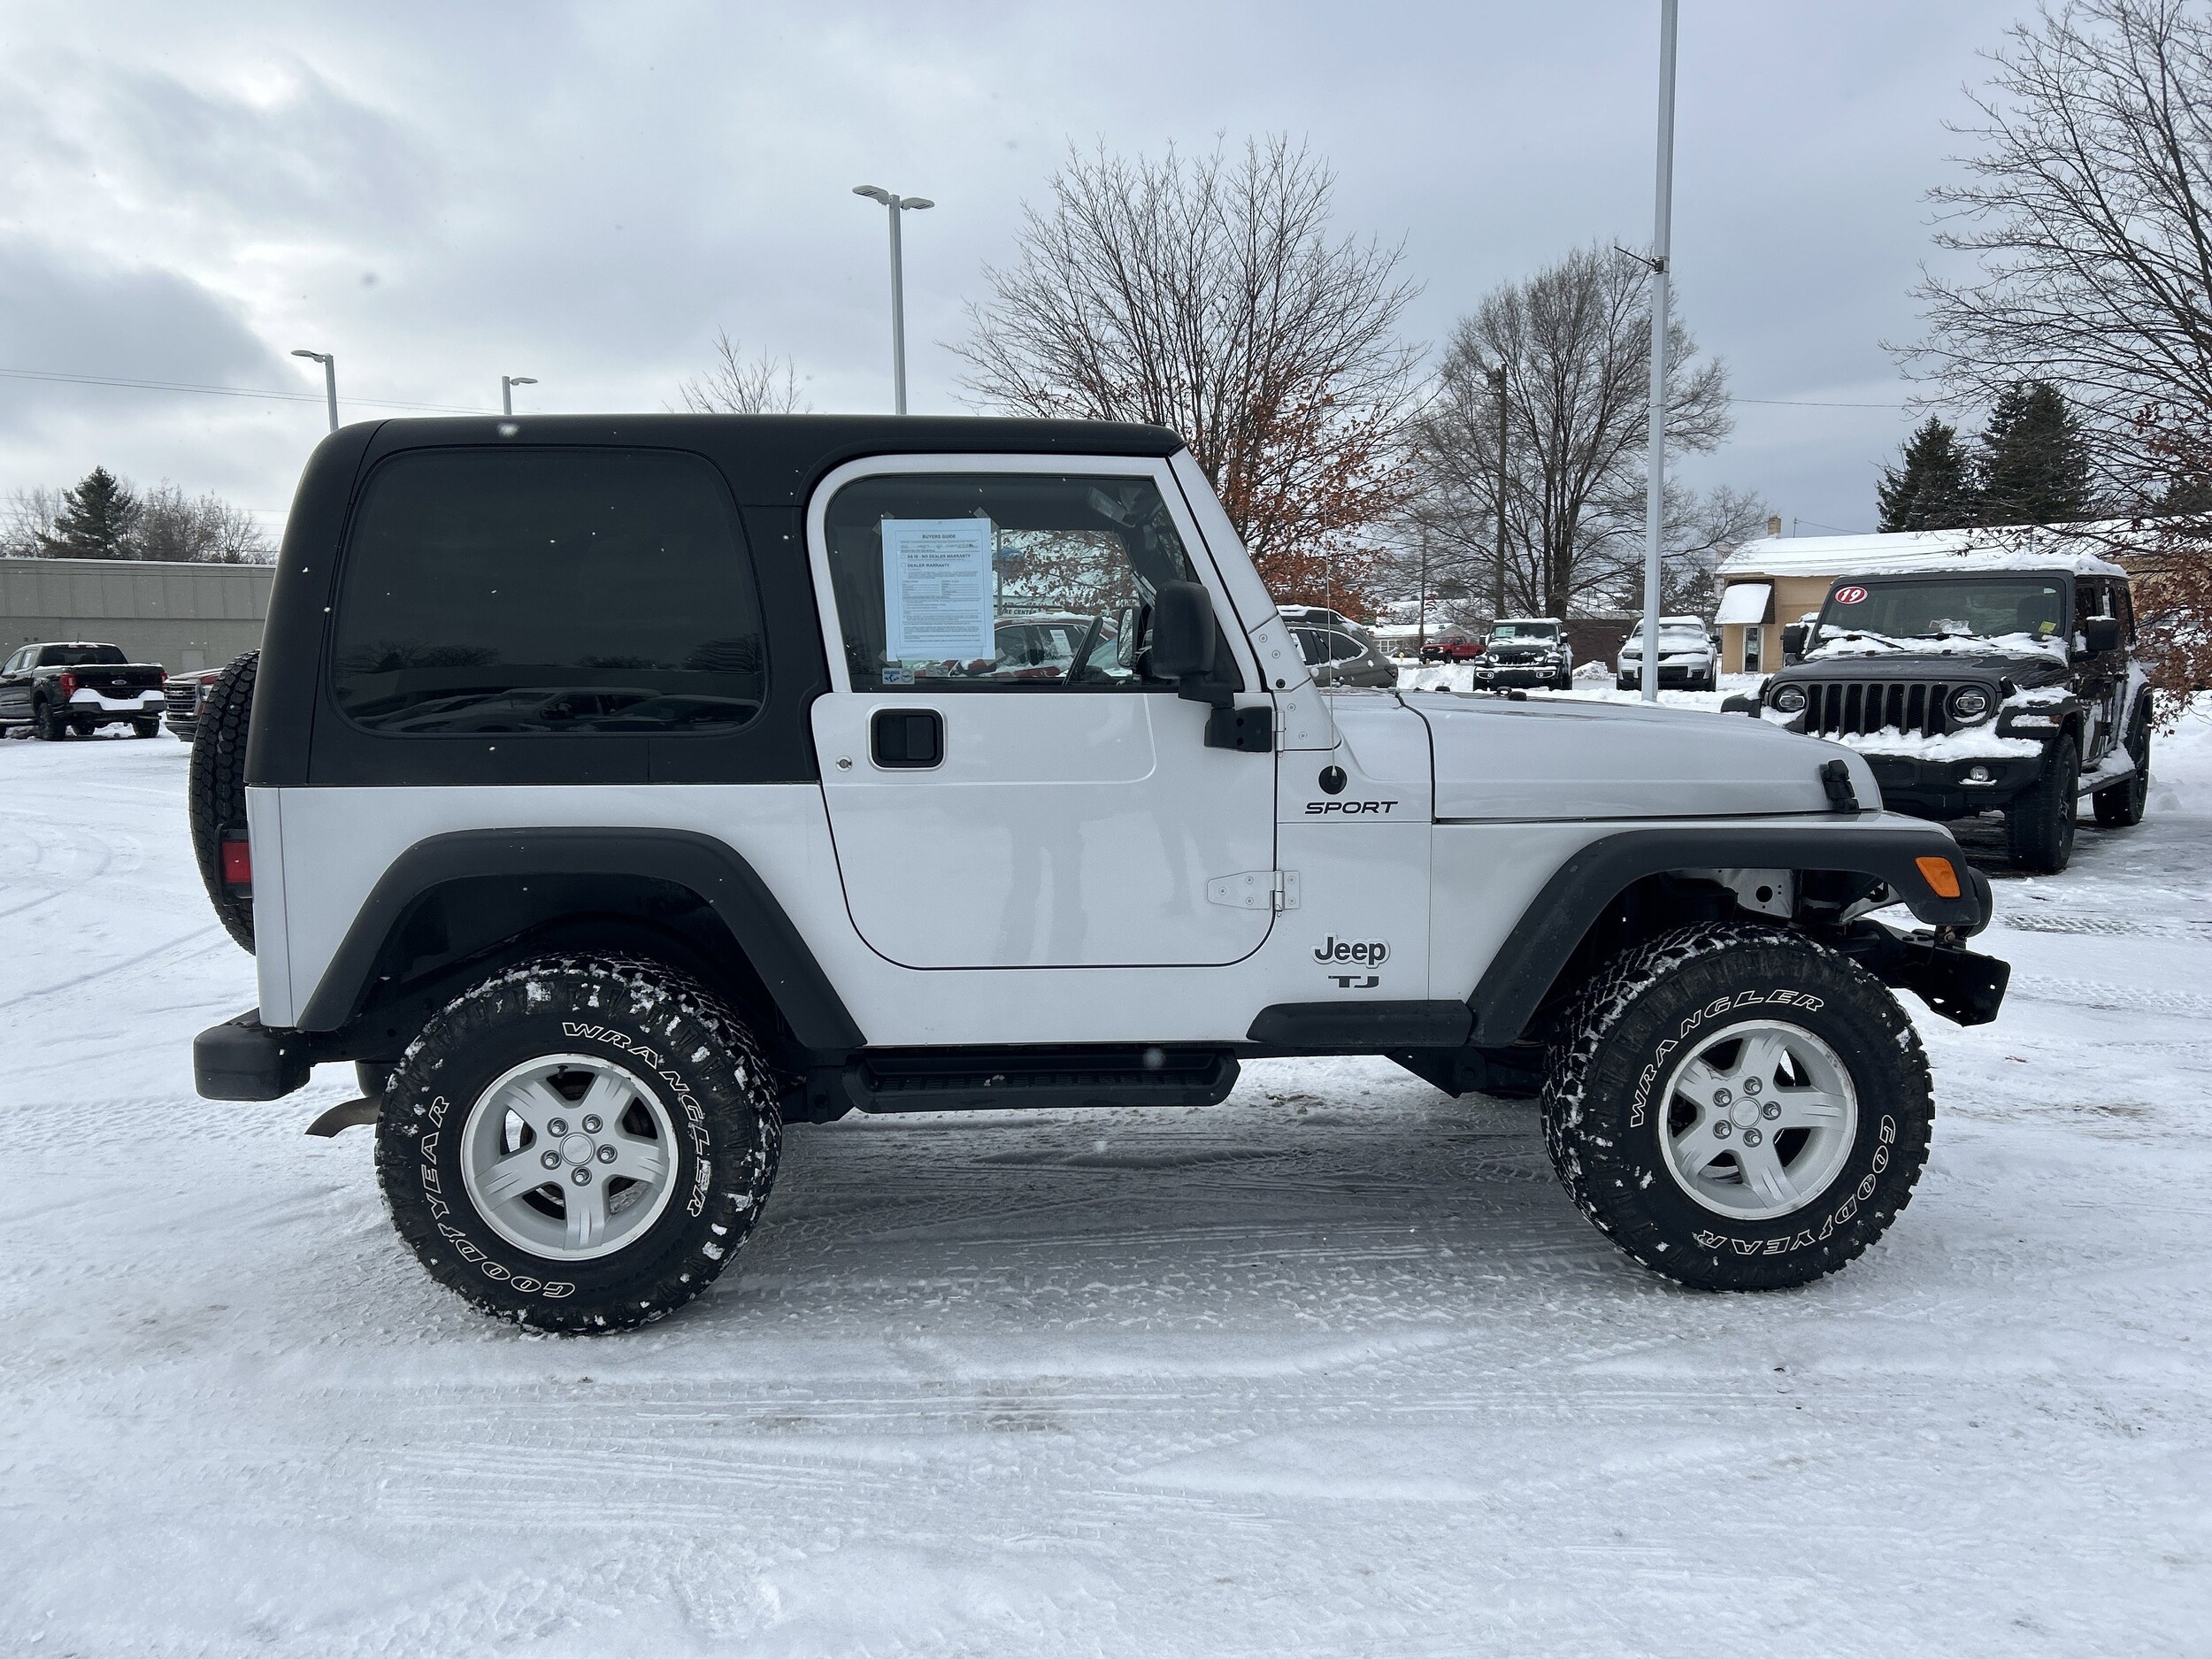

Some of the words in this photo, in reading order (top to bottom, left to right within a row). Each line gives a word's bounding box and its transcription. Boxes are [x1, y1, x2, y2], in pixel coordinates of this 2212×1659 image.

[1840, 588, 1862, 602] 19
[1304, 801, 1399, 814] SPORT
[1314, 936, 1386, 965] Jeep
[1327, 975, 1379, 988] TJ
[1630, 988, 1824, 1128] WRANGLER
[562, 1021, 710, 1218] WRANGLER
[420, 1095, 575, 1298] GOODYEAR
[1696, 1115, 1896, 1256] GOODYEAR
